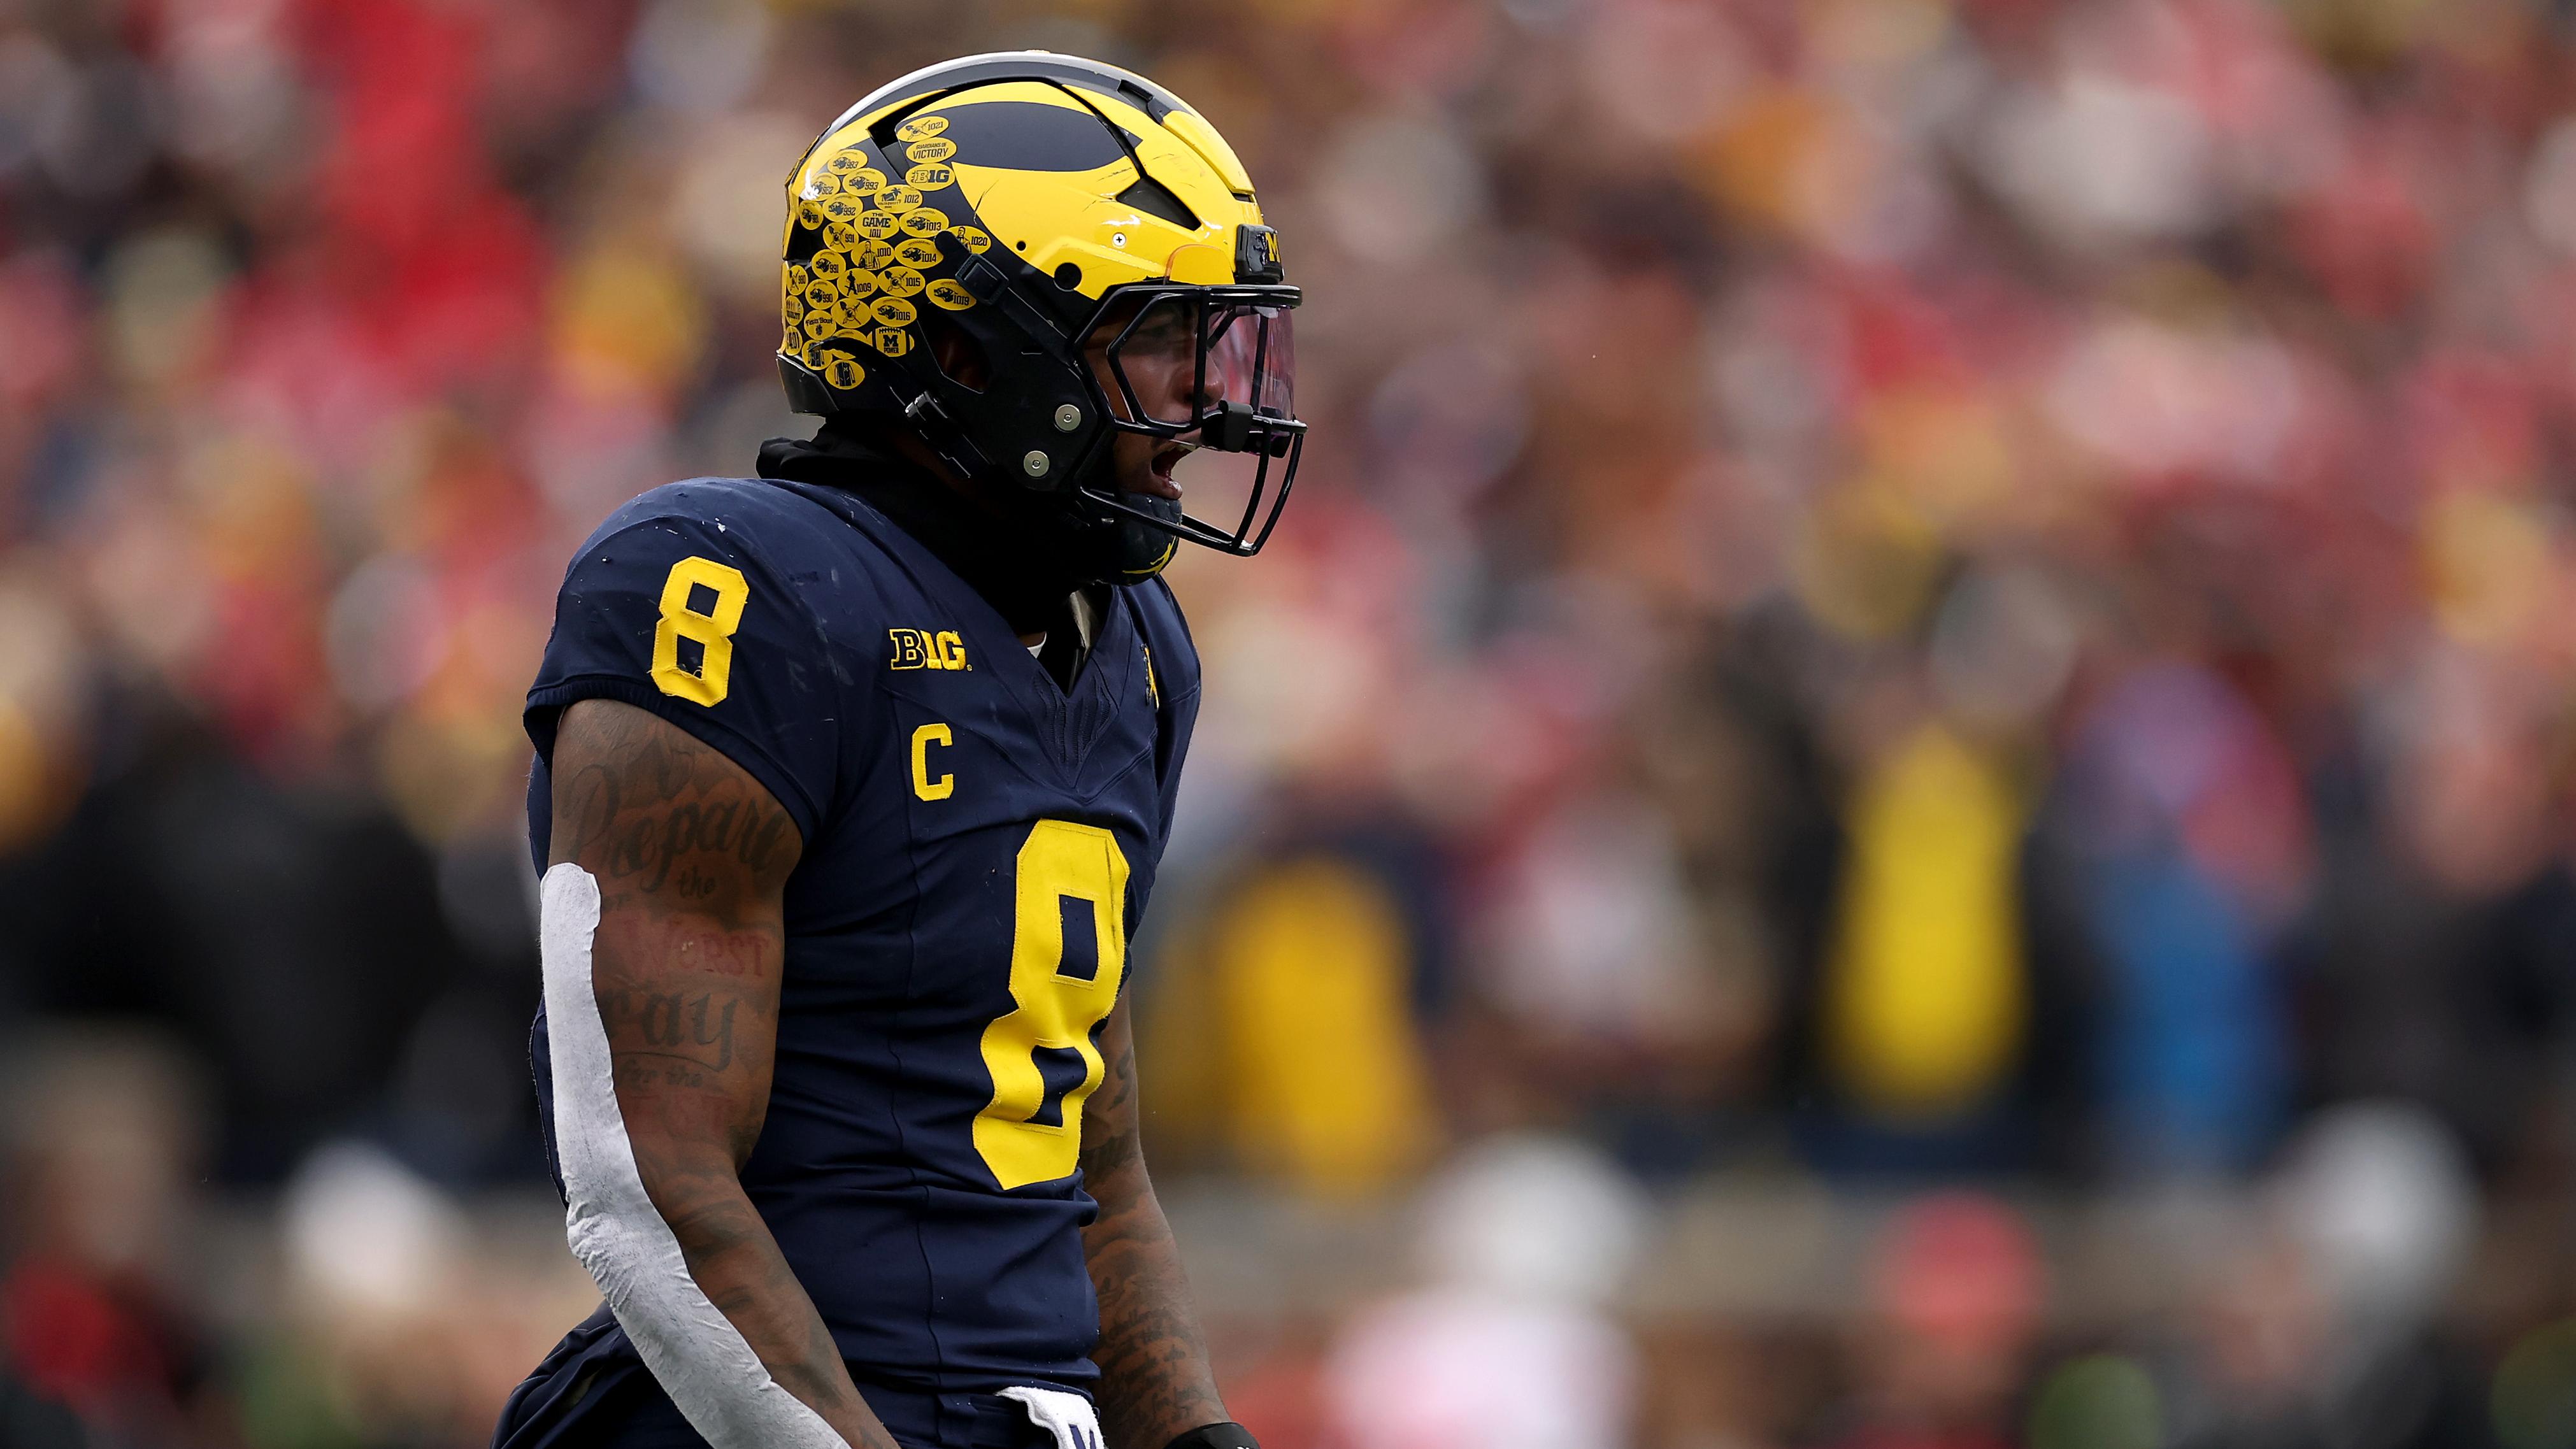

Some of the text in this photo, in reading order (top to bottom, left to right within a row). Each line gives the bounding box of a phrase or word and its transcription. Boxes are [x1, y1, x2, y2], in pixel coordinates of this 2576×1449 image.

[927, 121, 943, 131] 1021
[913, 148, 948, 159] VICTORY
[864, 182, 879, 190] 993
[904, 194, 919, 203] 1012
[843, 207, 856, 215] 992
[862, 217, 891, 227] GAME
[925, 222, 941, 231] 1013
[869, 229, 882, 238] 1011
[971, 236, 988, 246] 1020
[877, 247, 891, 257] 1010
[922, 253, 937, 262] 1014
[829, 264, 839, 273] 991
[906, 277, 920, 287] 1015
[857, 283, 871, 292] 1009
[953, 296, 970, 306] 1019
[896, 311, 910, 320] 1016
[883, 334, 899, 347] M
[650, 556, 749, 707] 8
[912, 723, 954, 801] C
[677, 864, 717, 899] the
[973, 819, 1129, 1190] 8
[601, 991, 738, 1073] ray
